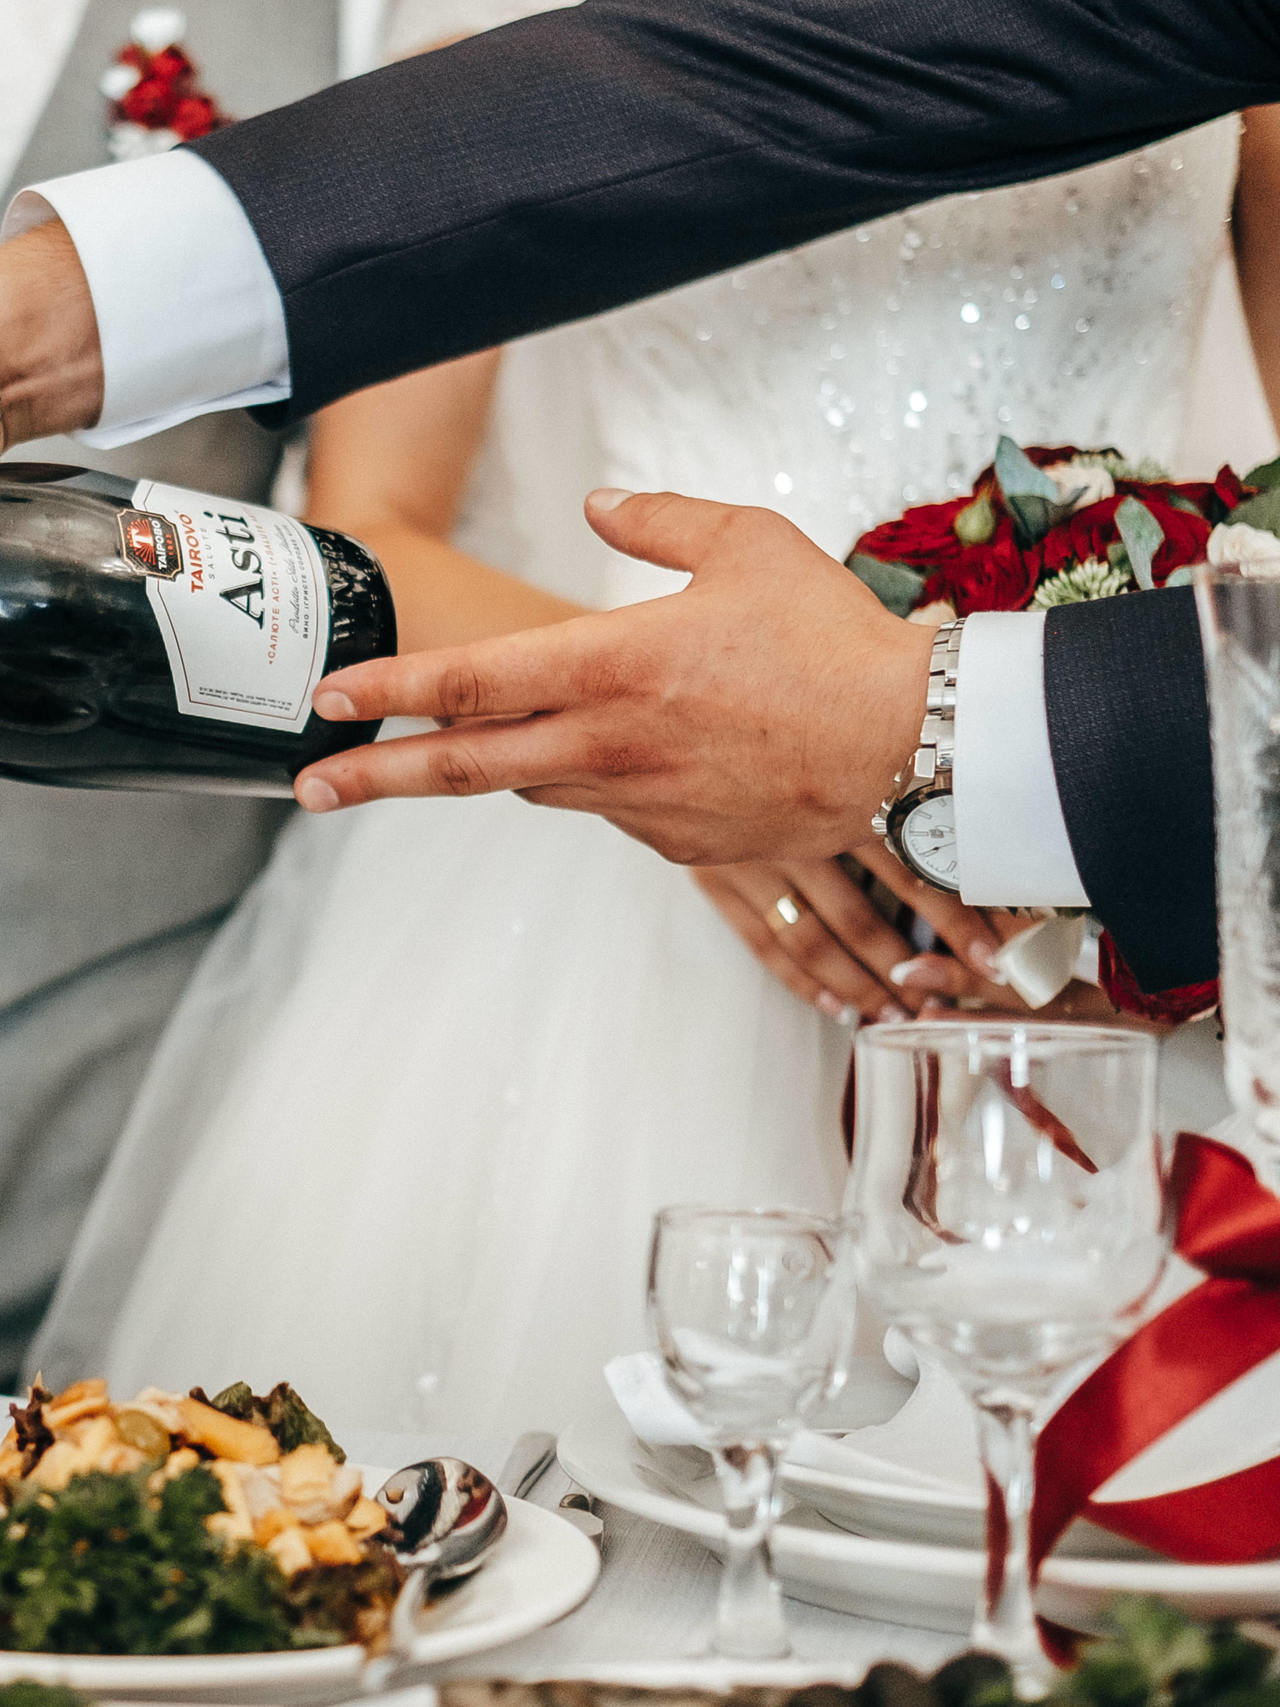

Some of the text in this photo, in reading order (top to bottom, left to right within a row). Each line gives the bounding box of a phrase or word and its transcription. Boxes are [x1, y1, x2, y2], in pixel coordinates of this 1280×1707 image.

[179, 513, 204, 593] TAIROVO
[200, 527, 216, 580] SALUTE
[203, 511, 265, 630] Asti
